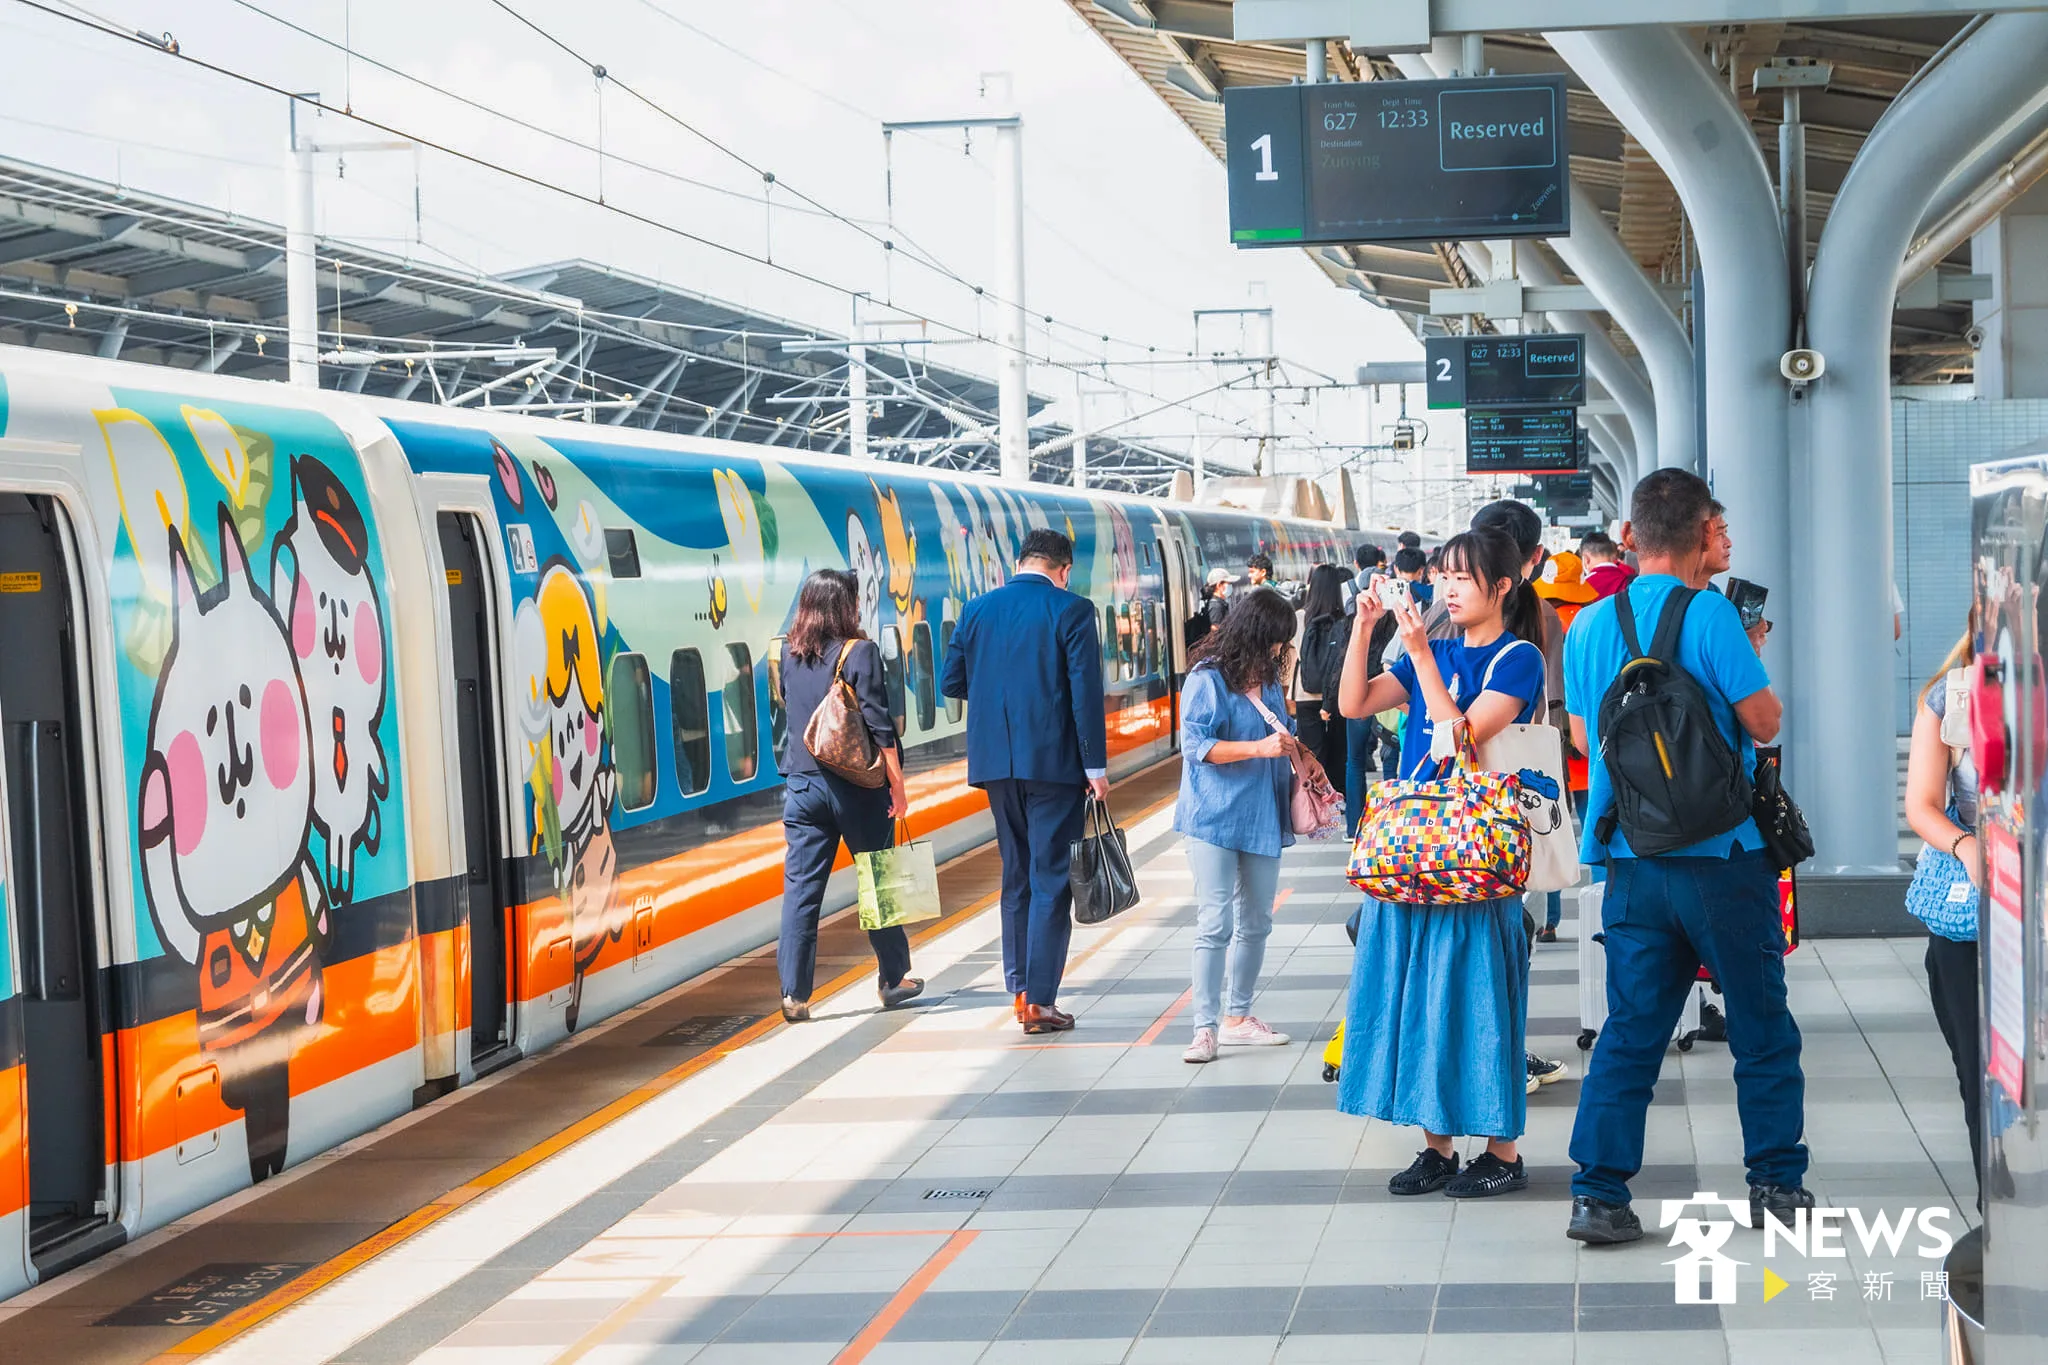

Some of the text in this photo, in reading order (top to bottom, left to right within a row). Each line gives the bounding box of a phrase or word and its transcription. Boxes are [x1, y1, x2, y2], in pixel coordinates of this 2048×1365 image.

[1323, 112, 1357, 131] 627
[1377, 109, 1429, 129] 12:33
[1450, 116, 1544, 140] Reserved
[1250, 133, 1279, 182] 1
[1471, 349, 1488, 359] 627
[1496, 347, 1521, 358] 12:33
[1530, 351, 1575, 364] Reserved
[1436, 358, 1452, 381] 2
[1534, 480, 1543, 492] 4
[512, 533, 522, 568] 2
